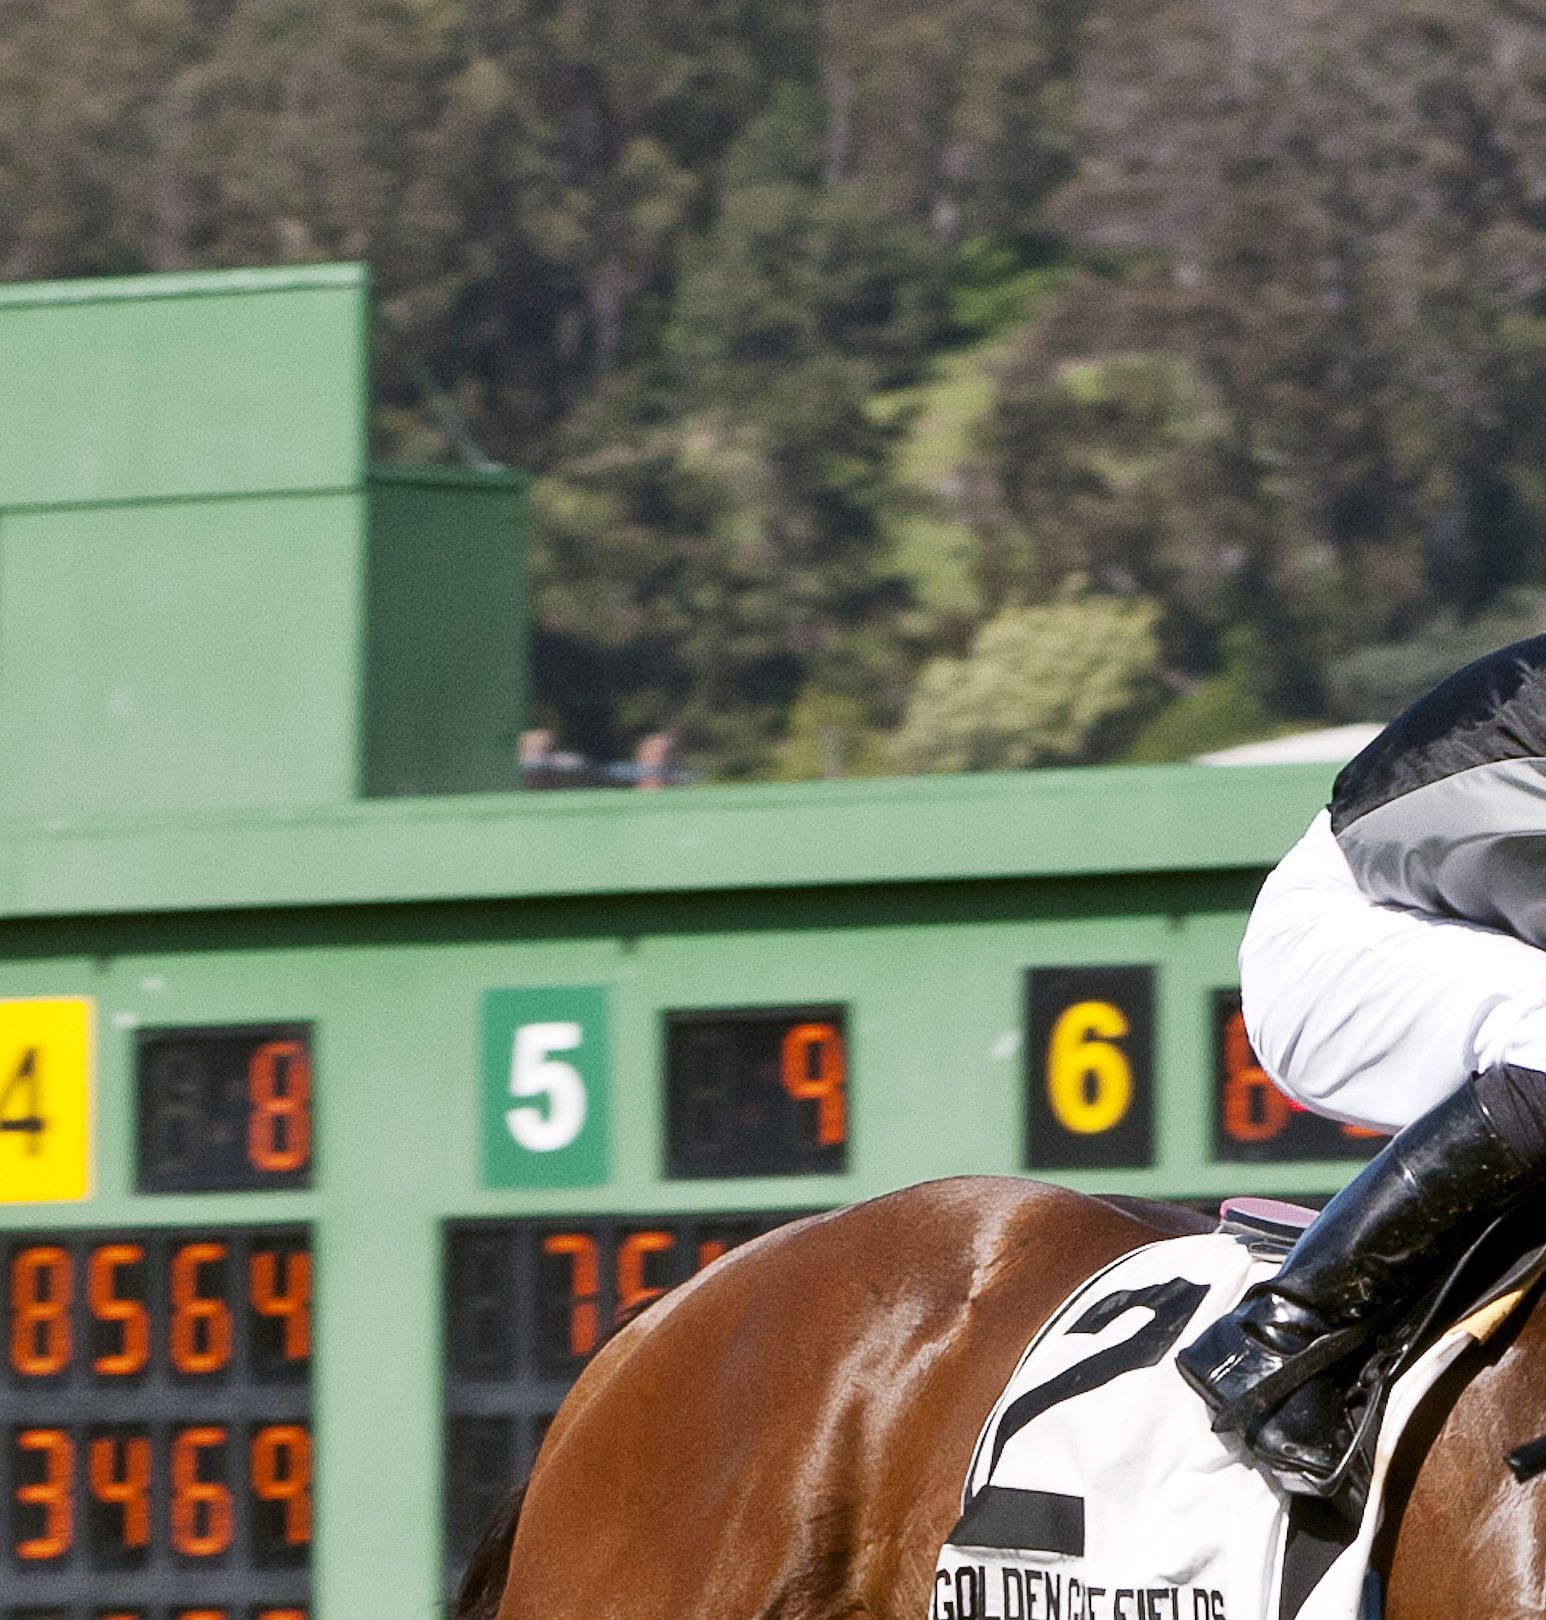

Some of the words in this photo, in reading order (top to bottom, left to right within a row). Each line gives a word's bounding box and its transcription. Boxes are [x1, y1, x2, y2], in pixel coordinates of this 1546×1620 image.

[248, 1040, 314, 1172] 8
[504, 1020, 589, 1153] 5
[779, 1022, 847, 1147] 9
[1046, 1000, 1133, 1134] 6
[8, 1244, 313, 1376] 8564
[944, 1276, 1212, 1558] 2
[15, 1426, 314, 1558] 3469
